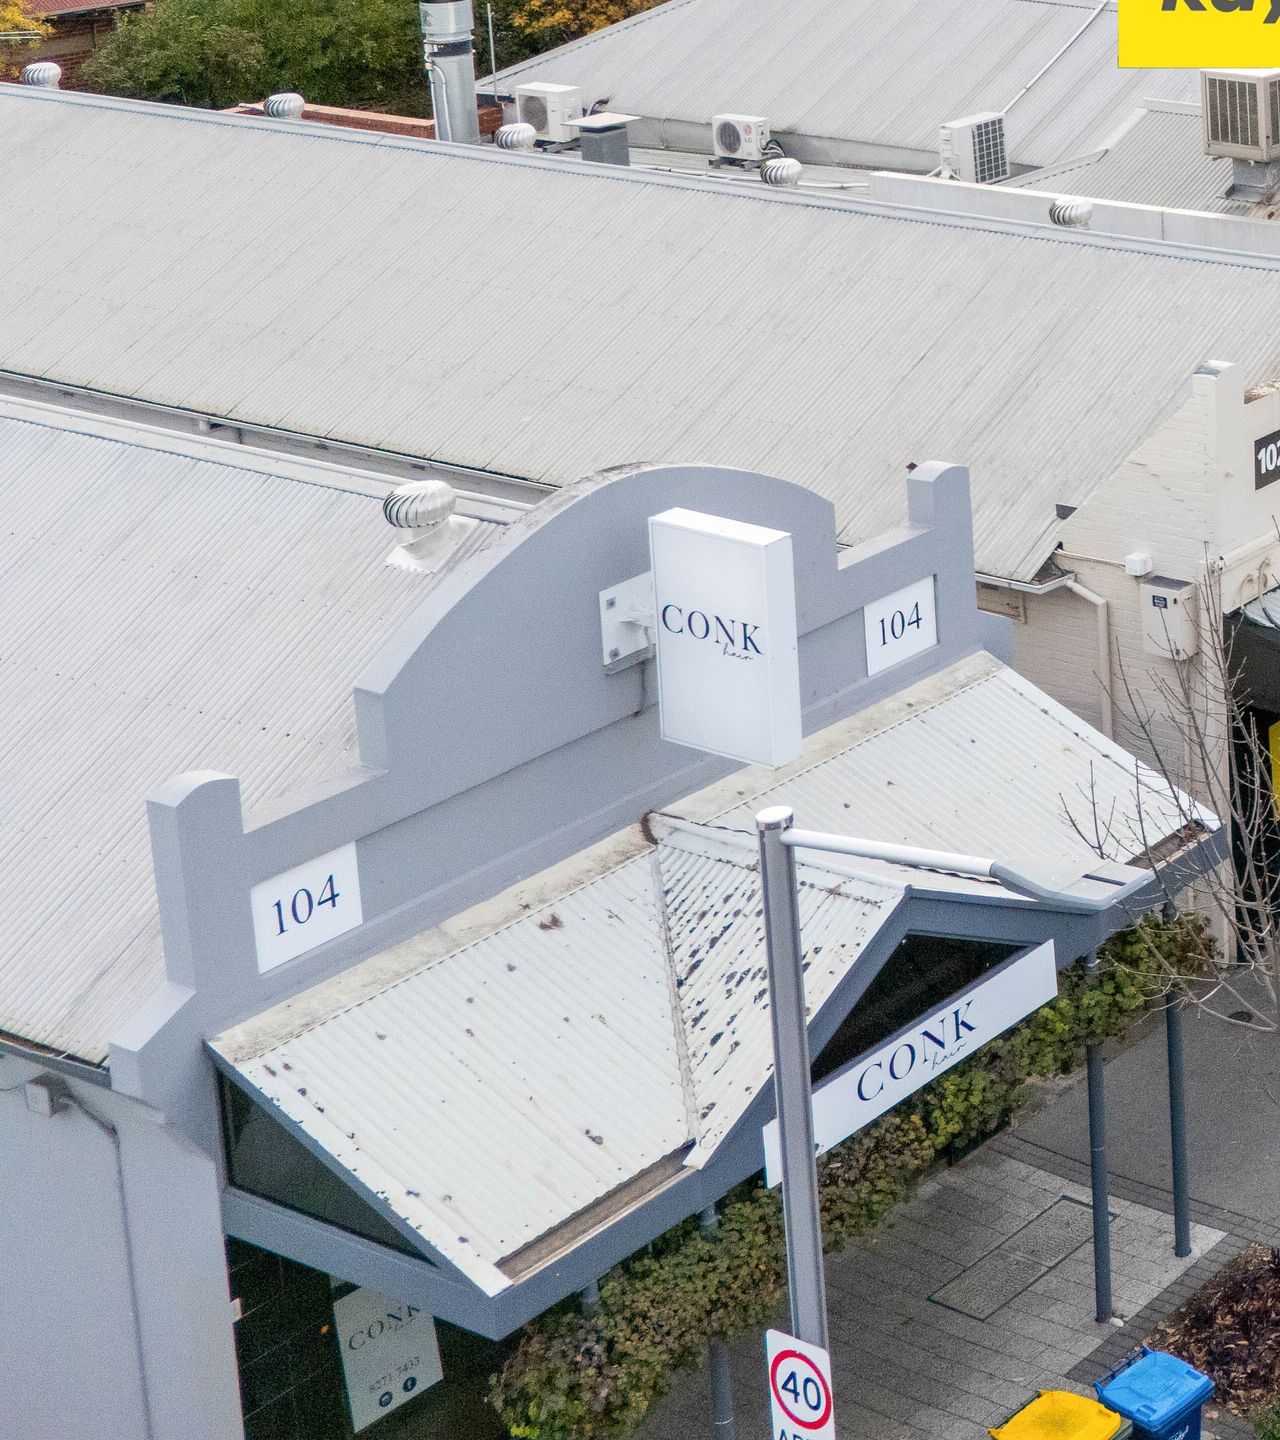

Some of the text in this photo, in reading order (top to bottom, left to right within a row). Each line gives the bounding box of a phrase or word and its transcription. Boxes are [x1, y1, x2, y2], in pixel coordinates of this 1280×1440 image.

[661, 604, 764, 656] CONK
[877, 600, 923, 648] 104
[271, 874, 340, 937] 104
[857, 999, 977, 1102] CONK
[781, 1371, 821, 1411] 40
